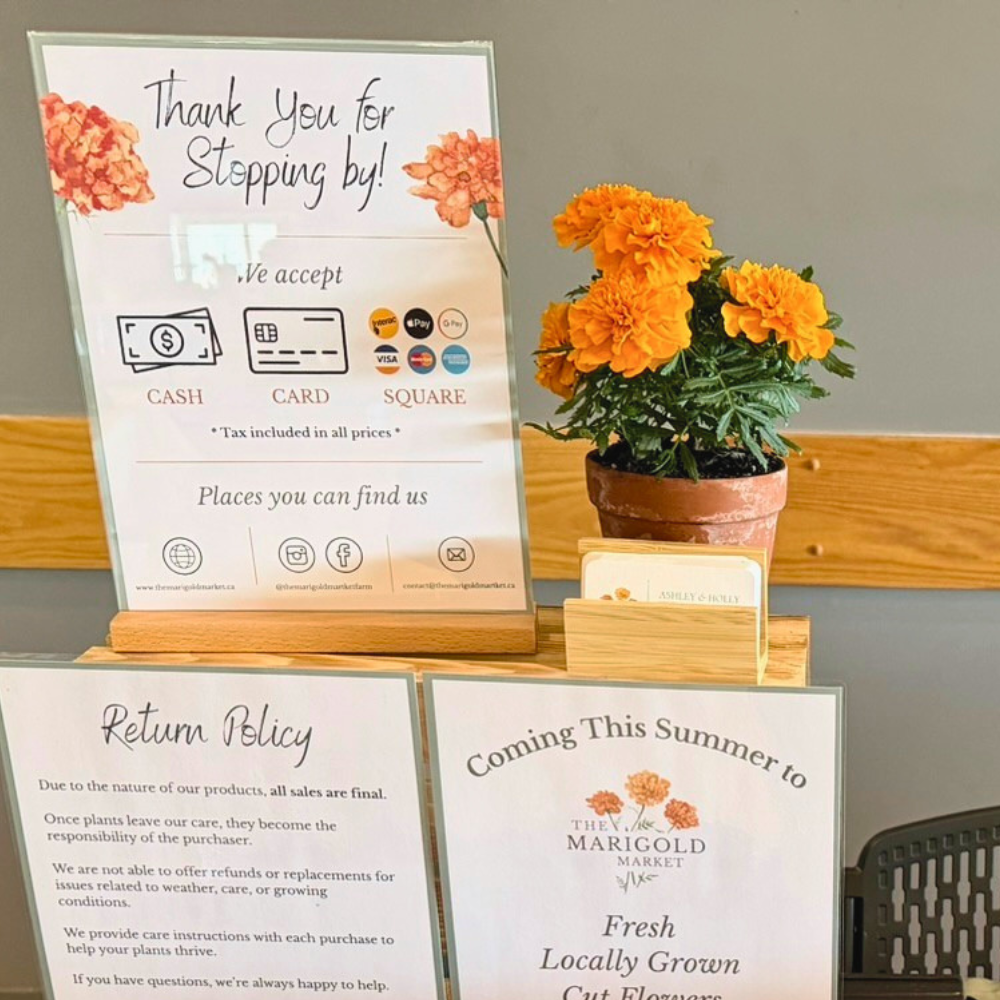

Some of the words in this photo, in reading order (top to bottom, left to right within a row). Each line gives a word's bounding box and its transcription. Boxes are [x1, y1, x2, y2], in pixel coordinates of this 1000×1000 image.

[144, 69, 248, 129] Thank
[265, 87, 339, 149] You
[354, 77, 395, 133] for
[183, 134, 327, 211] Stopping
[342, 134, 389, 212] by!
[275, 265, 343, 290] accept
[414, 318, 431, 331] Pay
[450, 320, 464, 329] Pay
[376, 355, 399, 364] VISA
[146, 388, 204, 405] CASH
[271, 388, 330, 405] CARD
[383, 388, 467, 408] SQUARE
[219, 426, 248, 439] Tax
[250, 426, 311, 439] included
[314, 426, 328, 439] in
[331, 426, 348, 438] all
[351, 426, 392, 441] prices
[198, 486, 264, 506] Places
[268, 490, 307, 510] you
[313, 490, 350, 505] can
[353, 485, 401, 511] find
[405, 489, 429, 505] us
[658, 590, 696, 602] ASHLEY
[697, 594, 706, 602] &
[707, 593, 741, 605] HOLLY
[101, 701, 209, 751] Return
[223, 702, 314, 768] Policy
[466, 725, 578, 779] Coming
[580, 714, 648, 742] This
[654, 717, 780, 773] Summer
[781, 763, 809, 790] to
[38, 778, 66, 792] Due
[69, 780, 84, 792] to
[86, 780, 109, 793] the
[112, 782, 156, 794] nature
[159, 781, 175, 795] of
[177, 786, 201, 796] our
[204, 784, 268, 798] products,
[269, 785, 287, 797] all
[290, 786, 323, 798] sales
[325, 789, 348, 798] are
[350, 786, 388, 799] final.
[44, 813, 81, 826] Once
[83, 814, 125, 829] plants
[127, 815, 161, 828] leave
[166, 819, 188, 829] our
[190, 818, 223, 830] care,
[225, 817, 255, 832] they
[258, 818, 313, 831] become
[315, 820, 337, 832] the
[571, 819, 609, 832] THE
[47, 831, 138, 845] responsibility
[140, 831, 155, 844] of
[157, 832, 180, 845] the
[183, 833, 254, 848] purchaser.
[566, 834, 707, 855] MARIGOLD
[617, 855, 685, 869] MARKET
[52, 862, 75, 875] We
[77, 866, 99, 876] are
[102, 866, 124, 877] not
[127, 864, 155, 877] able
[157, 866, 173, 877] to
[175, 865, 208, 878] offer
[210, 866, 263, 879] refunds
[265, 870, 280, 879] or
[283, 869, 372, 882] replacements
[375, 870, 396, 882] for
[55, 879, 94, 891] issues
[97, 880, 143, 893] related
[145, 881, 160, 893] to
[162, 881, 218, 895] weather,
[220, 884, 253, 896] care,
[255, 885, 271, 896] or
[273, 884, 328, 898] growing
[58, 896, 132, 909] conditions.
[602, 914, 676, 939] Fresh
[63, 928, 86, 940] We
[88, 928, 140, 943] provide
[142, 931, 170, 941] care
[172, 929, 251, 943] instructions
[253, 931, 283, 943] with
[285, 931, 317, 944] each
[319, 932, 378, 947] purchase
[380, 934, 395, 945] to
[66, 943, 96, 957] help
[99, 945, 130, 957] your
[132, 943, 172, 957] plants
[174, 945, 218, 957] thrive.
[538, 947, 639, 979] Locally
[647, 950, 741, 976] Grown
[73, 973, 84, 985] If
[85, 976, 111, 989] you
[114, 974, 145, 987] have
[147, 975, 213, 990] questions,
[215, 977, 249, 989] we're
[252, 977, 295, 991] always
[297, 978, 338, 993] happy
[340, 980, 355, 991] to
[357, 979, 390, 993] help.
